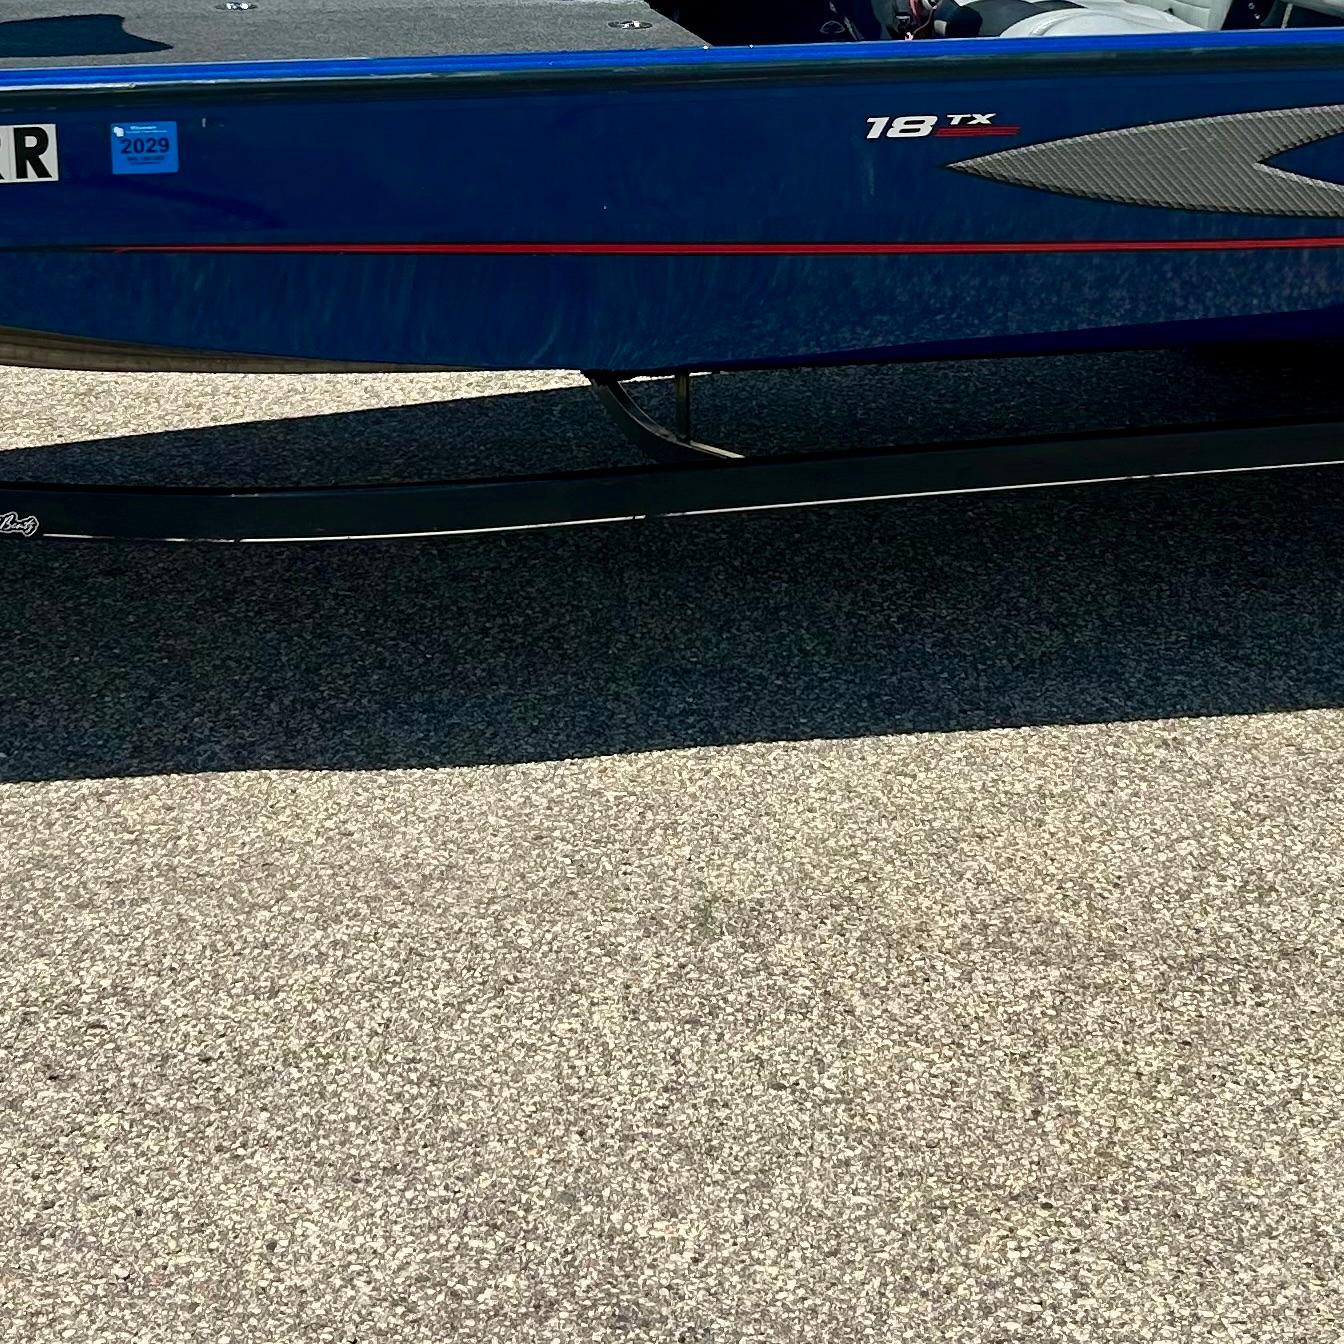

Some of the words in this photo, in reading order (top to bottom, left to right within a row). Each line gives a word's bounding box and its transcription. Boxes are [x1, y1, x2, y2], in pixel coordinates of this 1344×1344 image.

[865, 115, 939, 140] 18
[946, 112, 998, 126] TX
[120, 137, 170, 154] 2029
